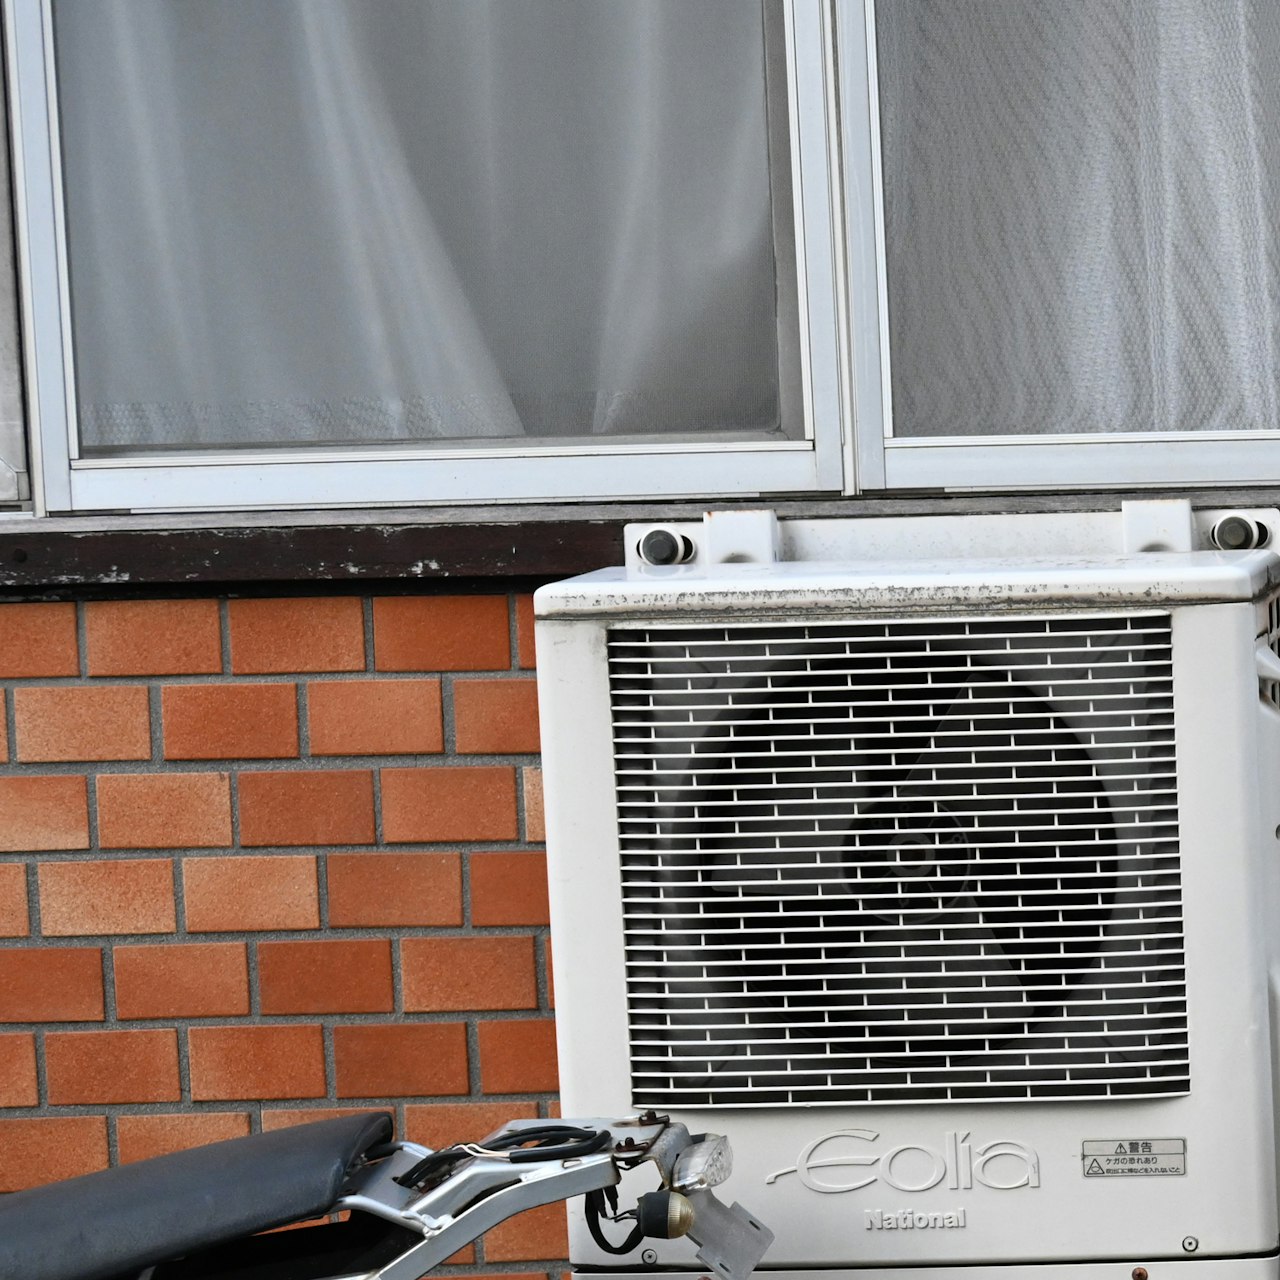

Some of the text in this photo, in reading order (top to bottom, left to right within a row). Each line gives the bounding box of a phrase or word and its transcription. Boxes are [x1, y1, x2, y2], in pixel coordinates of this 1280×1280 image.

[1129, 1141, 1152, 1154] 警告
[1105, 1156, 1158, 1165] ケガの恐れあり
[864, 1208, 966, 1229] National
